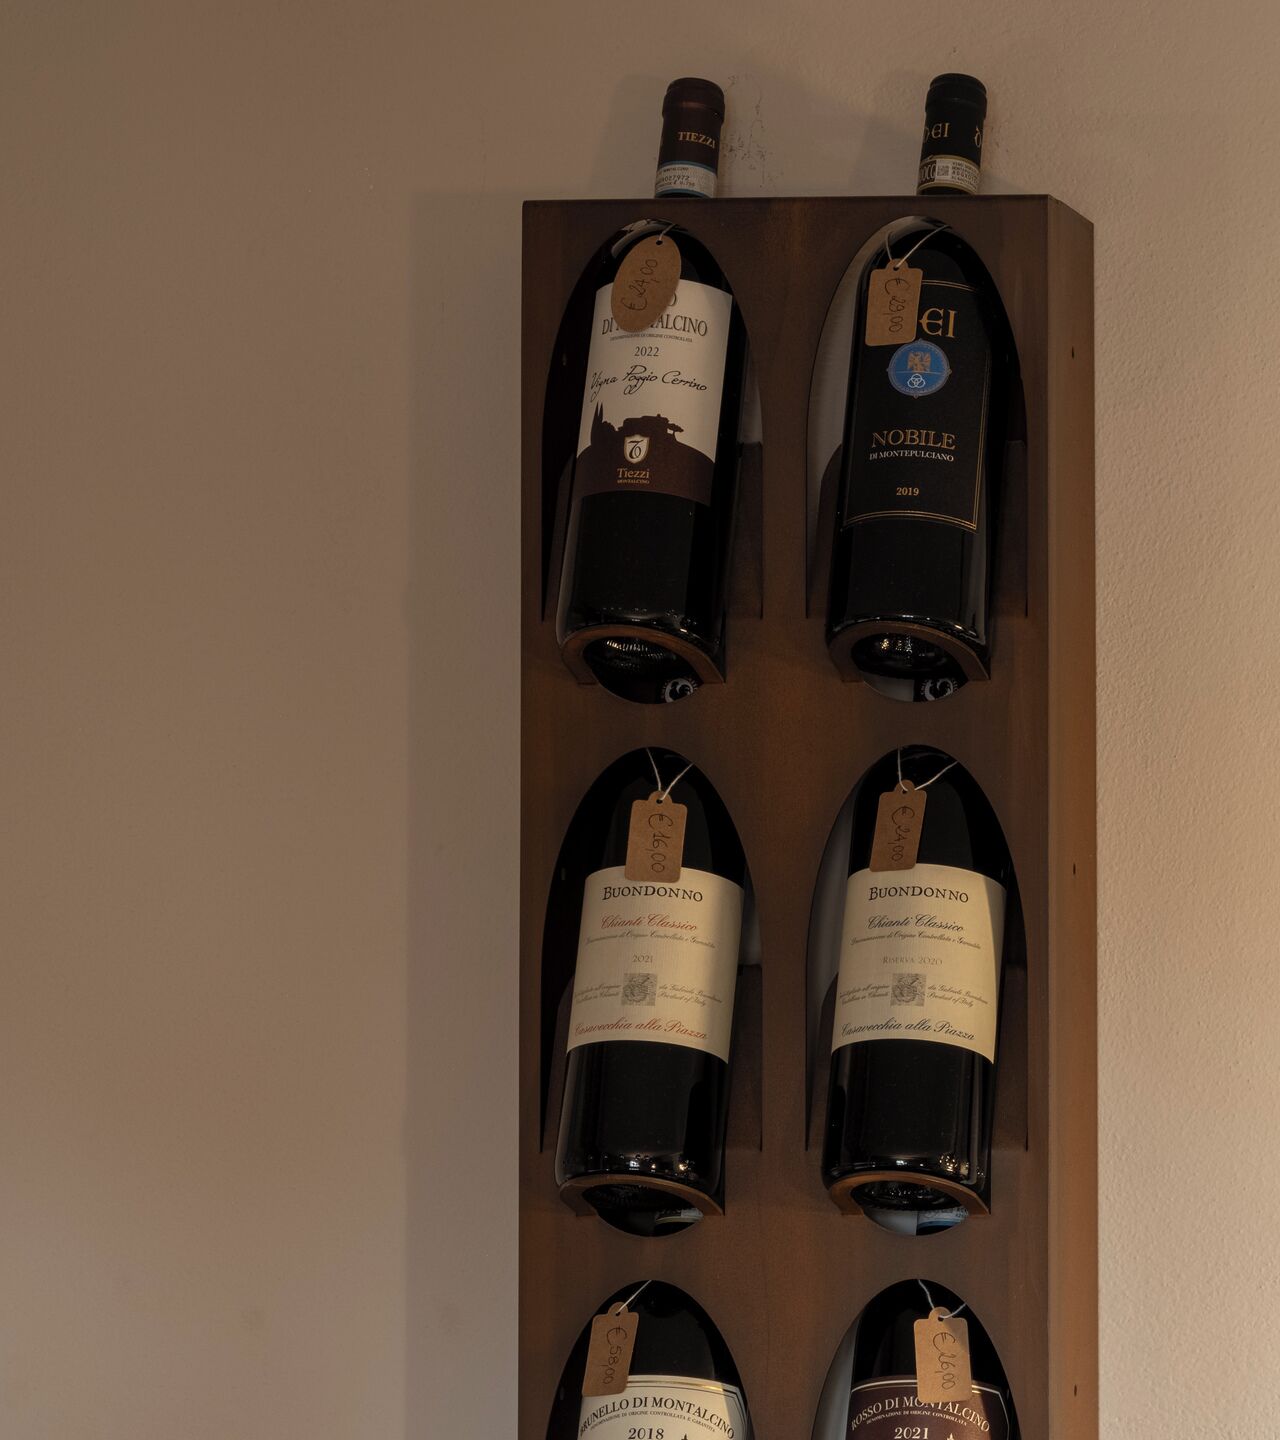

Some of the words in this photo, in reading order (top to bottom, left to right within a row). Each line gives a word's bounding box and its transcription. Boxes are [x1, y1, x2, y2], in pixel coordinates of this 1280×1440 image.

[678, 132, 716, 149] TIEZZI
[602, 318, 613, 335] DI
[635, 346, 659, 356] 2022
[590, 371, 618, 403] Vigna
[622, 365, 657, 395] Poggio
[662, 371, 707, 391] Cerrino
[871, 429, 956, 450] NOBILE
[870, 452, 877, 460] DI
[879, 449, 954, 462] MONTEPULCIANO
[617, 468, 649, 478] Tiezzi
[896, 486, 920, 496] 2019
[601, 915, 644, 929] Chianti
[647, 913, 697, 931] Classico
[867, 915, 913, 929] Chianti
[915, 914, 963, 932] Classico
[635, 1018, 661, 1031] alla
[841, 1017, 902, 1037] Casavecchia
[905, 1019, 931, 1032] alla
[934, 1020, 975, 1040] Piazza
[633, 1397, 648, 1408] DI
[652, 1397, 734, 1439] MONTALCINO
[851, 1402, 882, 1431] ROSSO
[885, 1397, 899, 1410] DI
[628, 1428, 664, 1440] 2018
[894, 1427, 929, 1439] 2021
